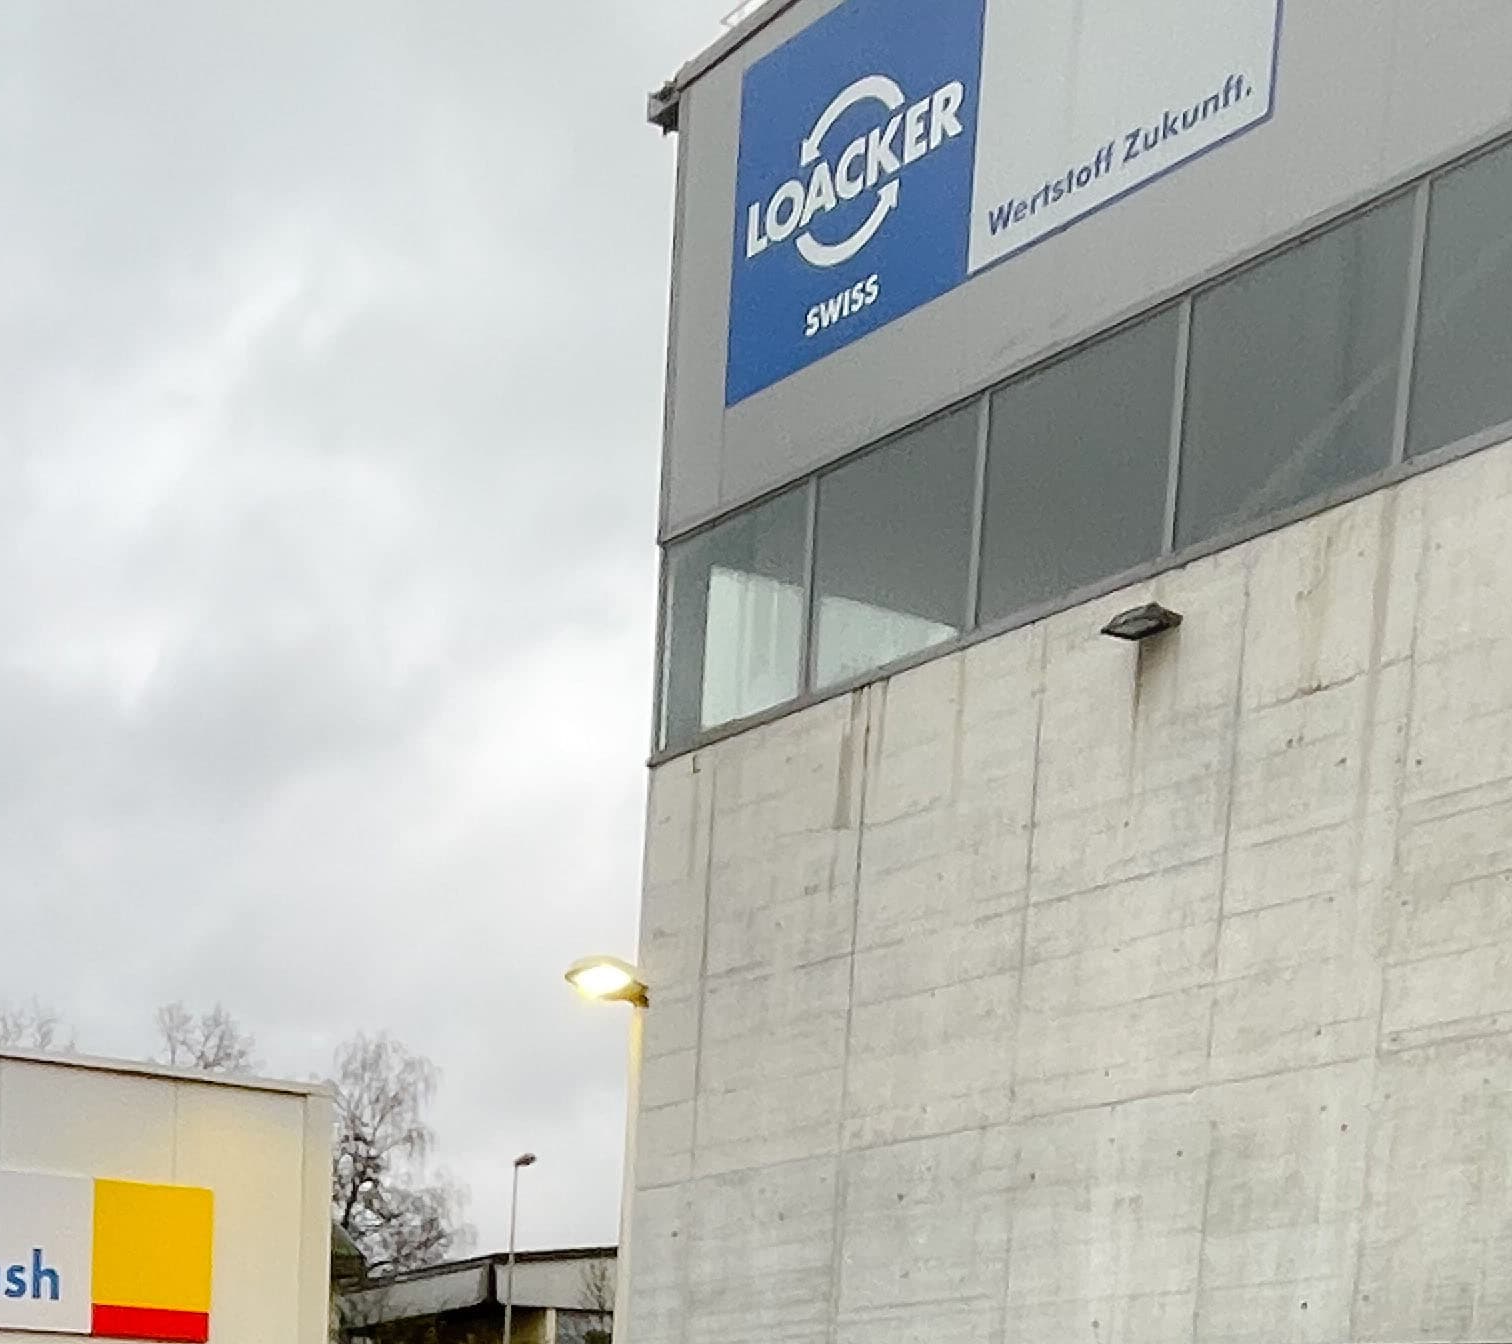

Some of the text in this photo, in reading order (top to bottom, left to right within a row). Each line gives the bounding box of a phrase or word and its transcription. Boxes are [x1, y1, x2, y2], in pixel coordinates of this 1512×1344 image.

[746, 80, 964, 258] LOACKER
[988, 74, 1253, 235] Wertstoff Zukunft.
[805, 274, 881, 338] SWISS
